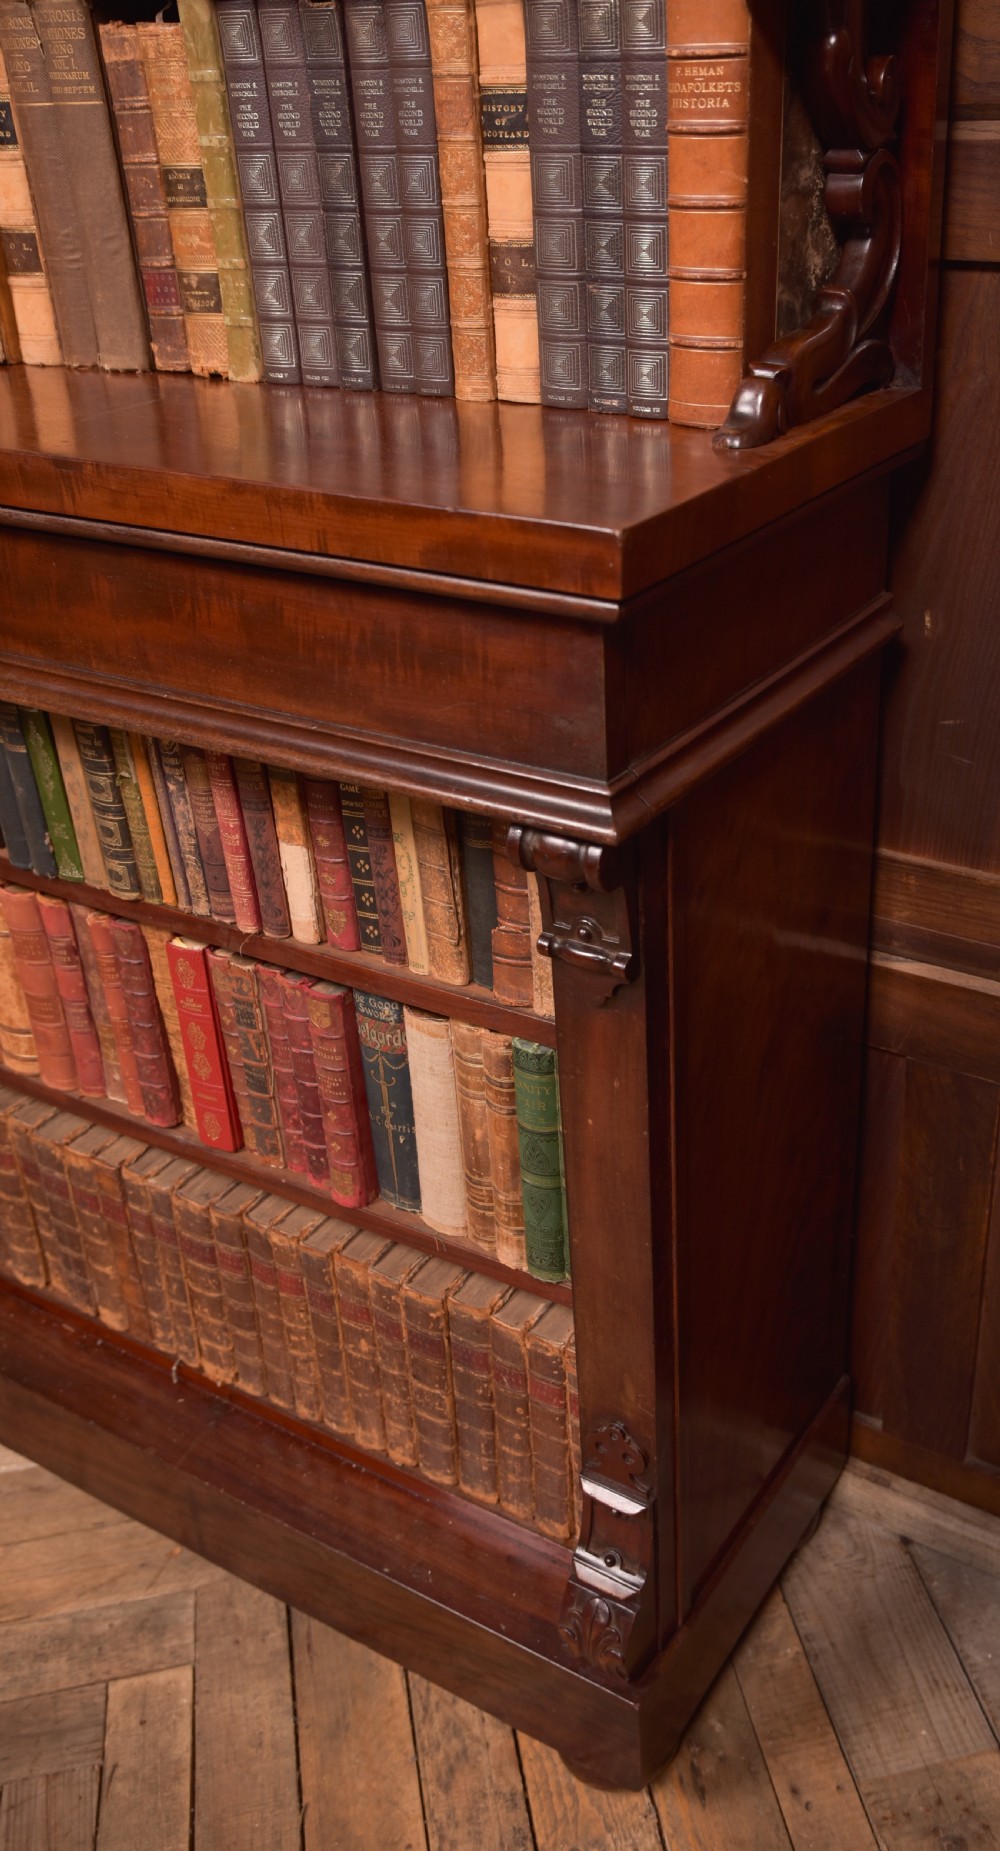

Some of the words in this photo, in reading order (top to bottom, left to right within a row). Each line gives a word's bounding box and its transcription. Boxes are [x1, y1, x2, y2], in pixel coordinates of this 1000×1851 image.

[684, 66, 725, 76] HEMAN
[668, 82, 742, 93] UDAFOLKETS
[542, 98, 558, 106] THE
[634, 100, 651, 108] THE
[672, 97, 731, 108] HISTORIA
[482, 104, 524, 112] HISTORY
[537, 108, 565, 116] SECOND
[278, 112, 300, 120] SECOND
[586, 108, 614, 117] SECOND
[629, 109, 658, 118] SECOND
[238, 121, 260, 129] WORLD
[278, 121, 301, 129] WORLD
[538, 117, 565, 125] WORLD
[587, 118, 614, 126] WORLD
[630, 119, 658, 128] WORLD
[241, 130, 256, 138] WAR
[403, 128, 419, 136] WAR
[482, 130, 530, 138] SCOTLAND
[591, 128, 607, 136] WAR
[634, 130, 651, 138] WAR
[492, 256, 533, 267] VOL.
